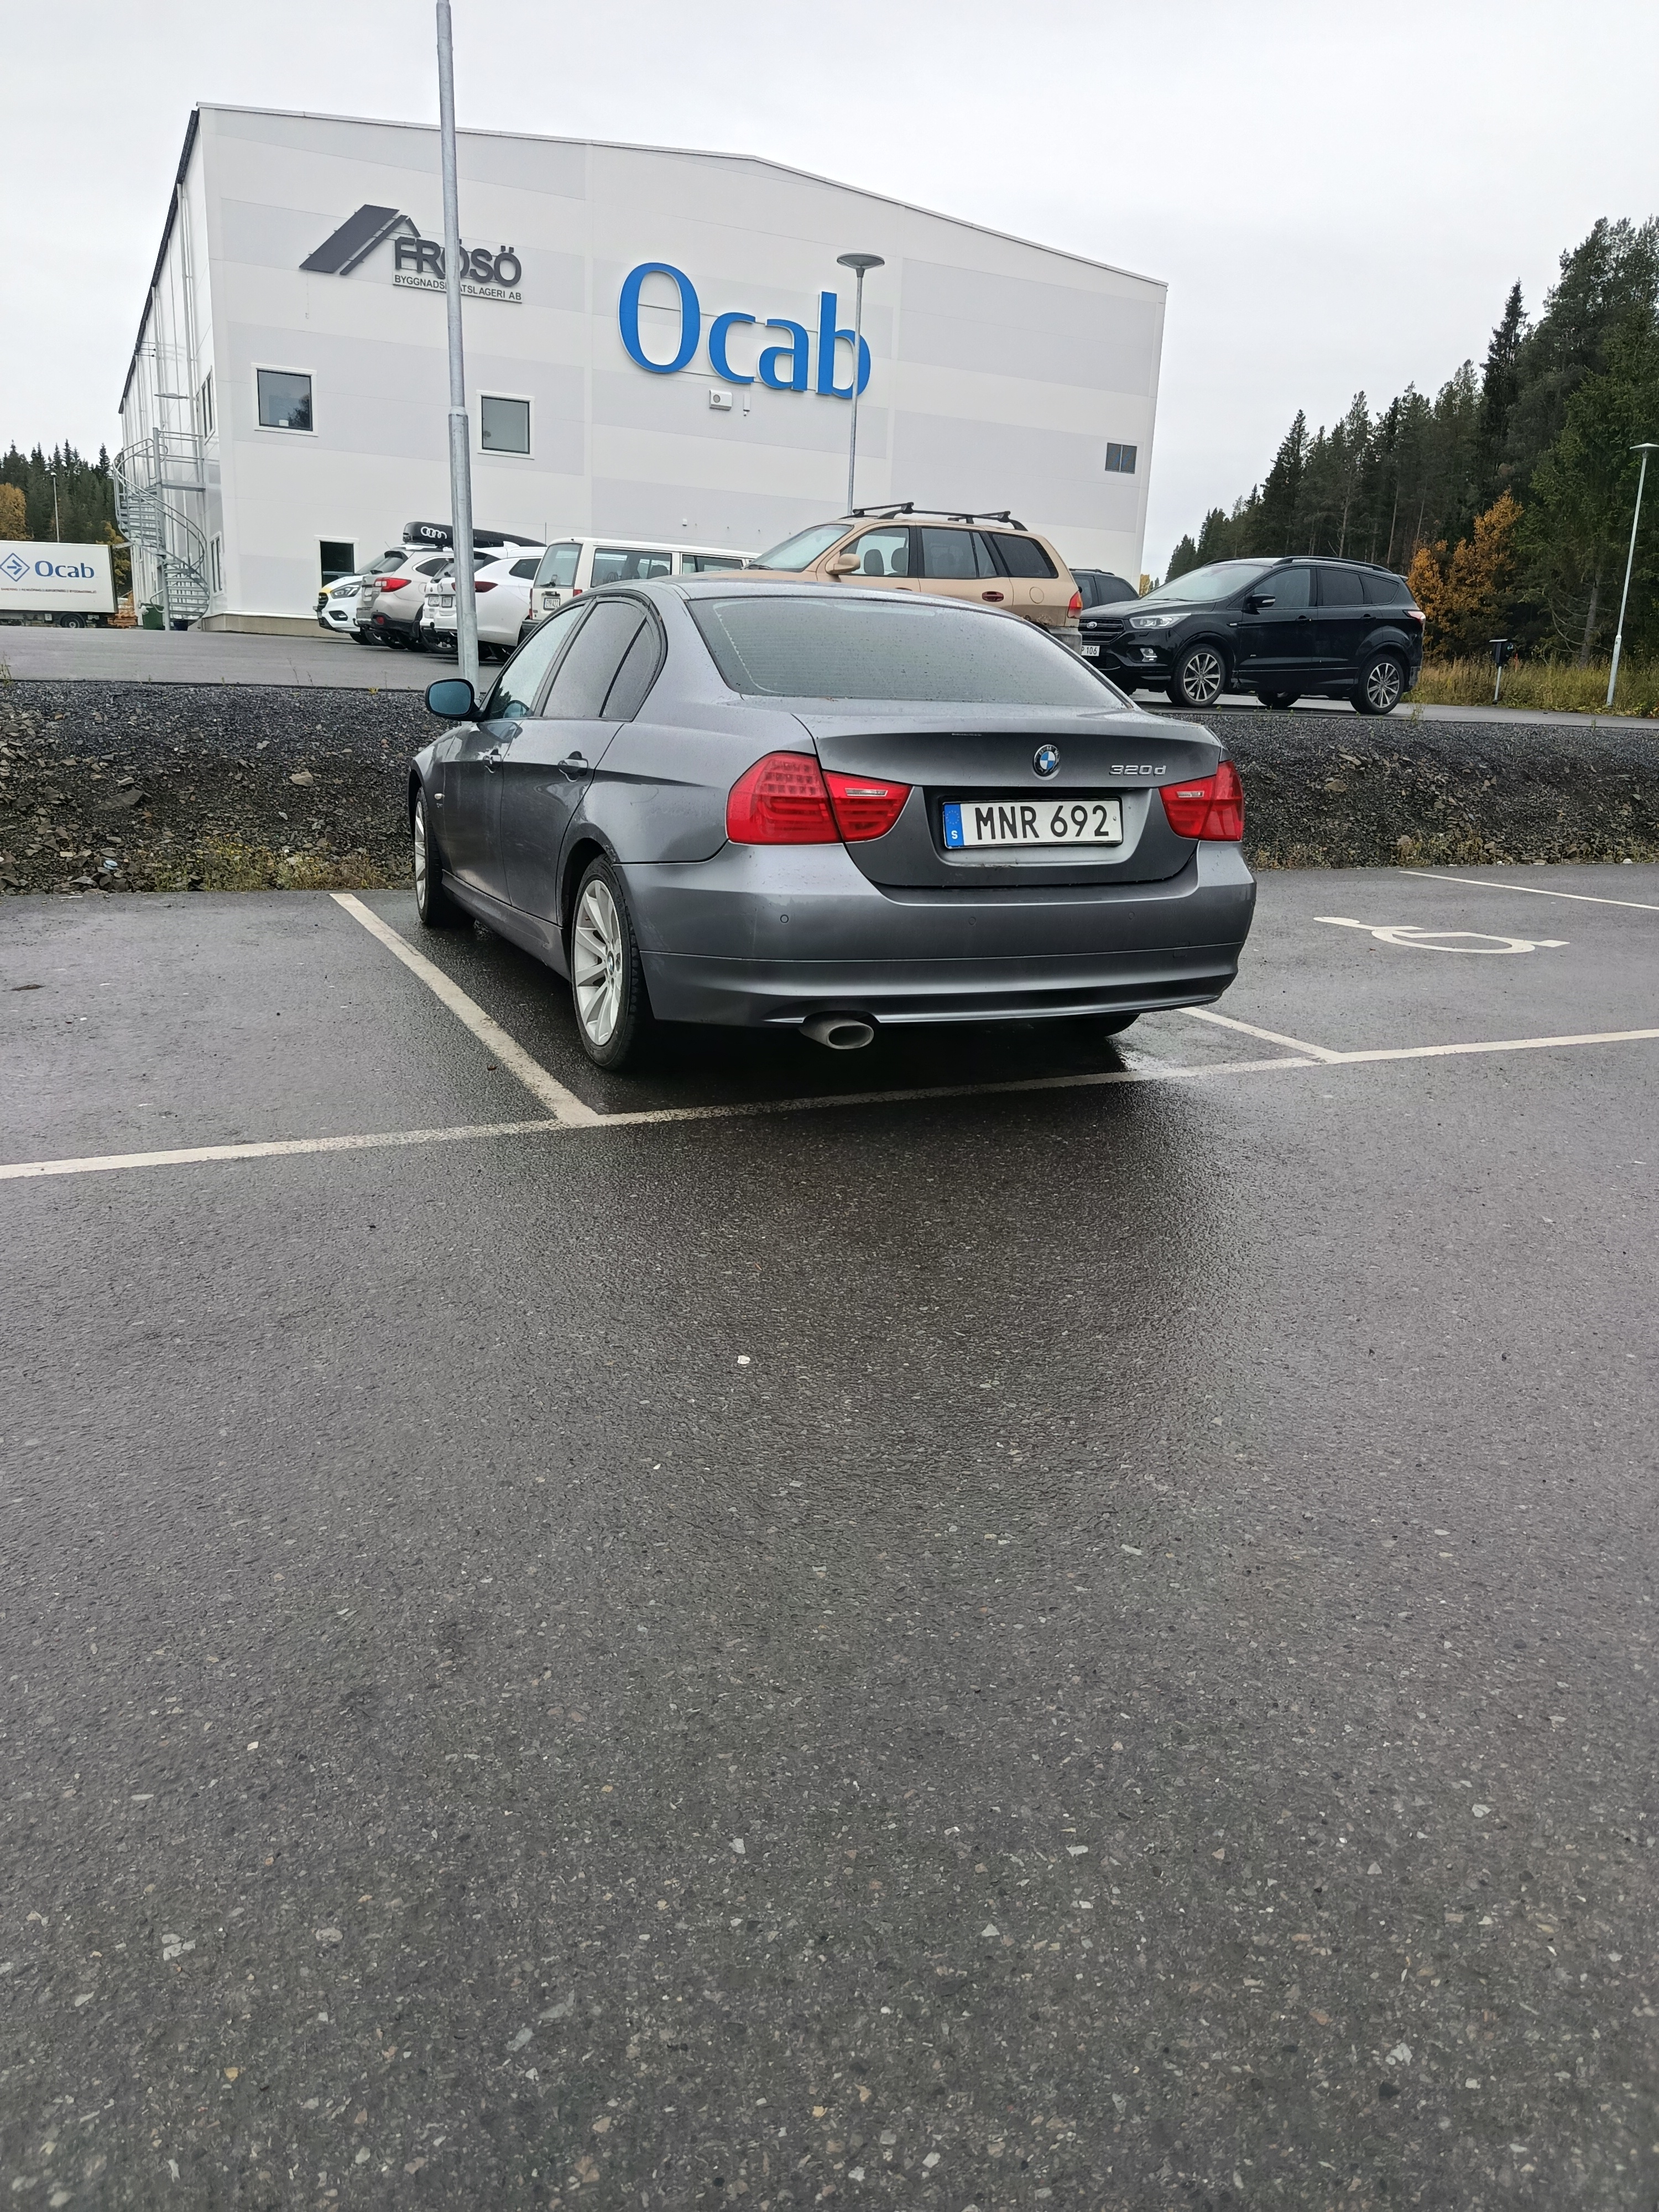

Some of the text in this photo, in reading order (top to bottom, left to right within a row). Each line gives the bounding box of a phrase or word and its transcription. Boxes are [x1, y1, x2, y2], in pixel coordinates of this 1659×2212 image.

[618, 262, 871, 399] Ocab
[35, 561, 95, 578] Ocab
[1087, 646, 1097, 655] 106
[1109, 765, 1166, 775] 320d
[975, 805, 1109, 841] MNR 692
[951, 830, 958, 839] S
